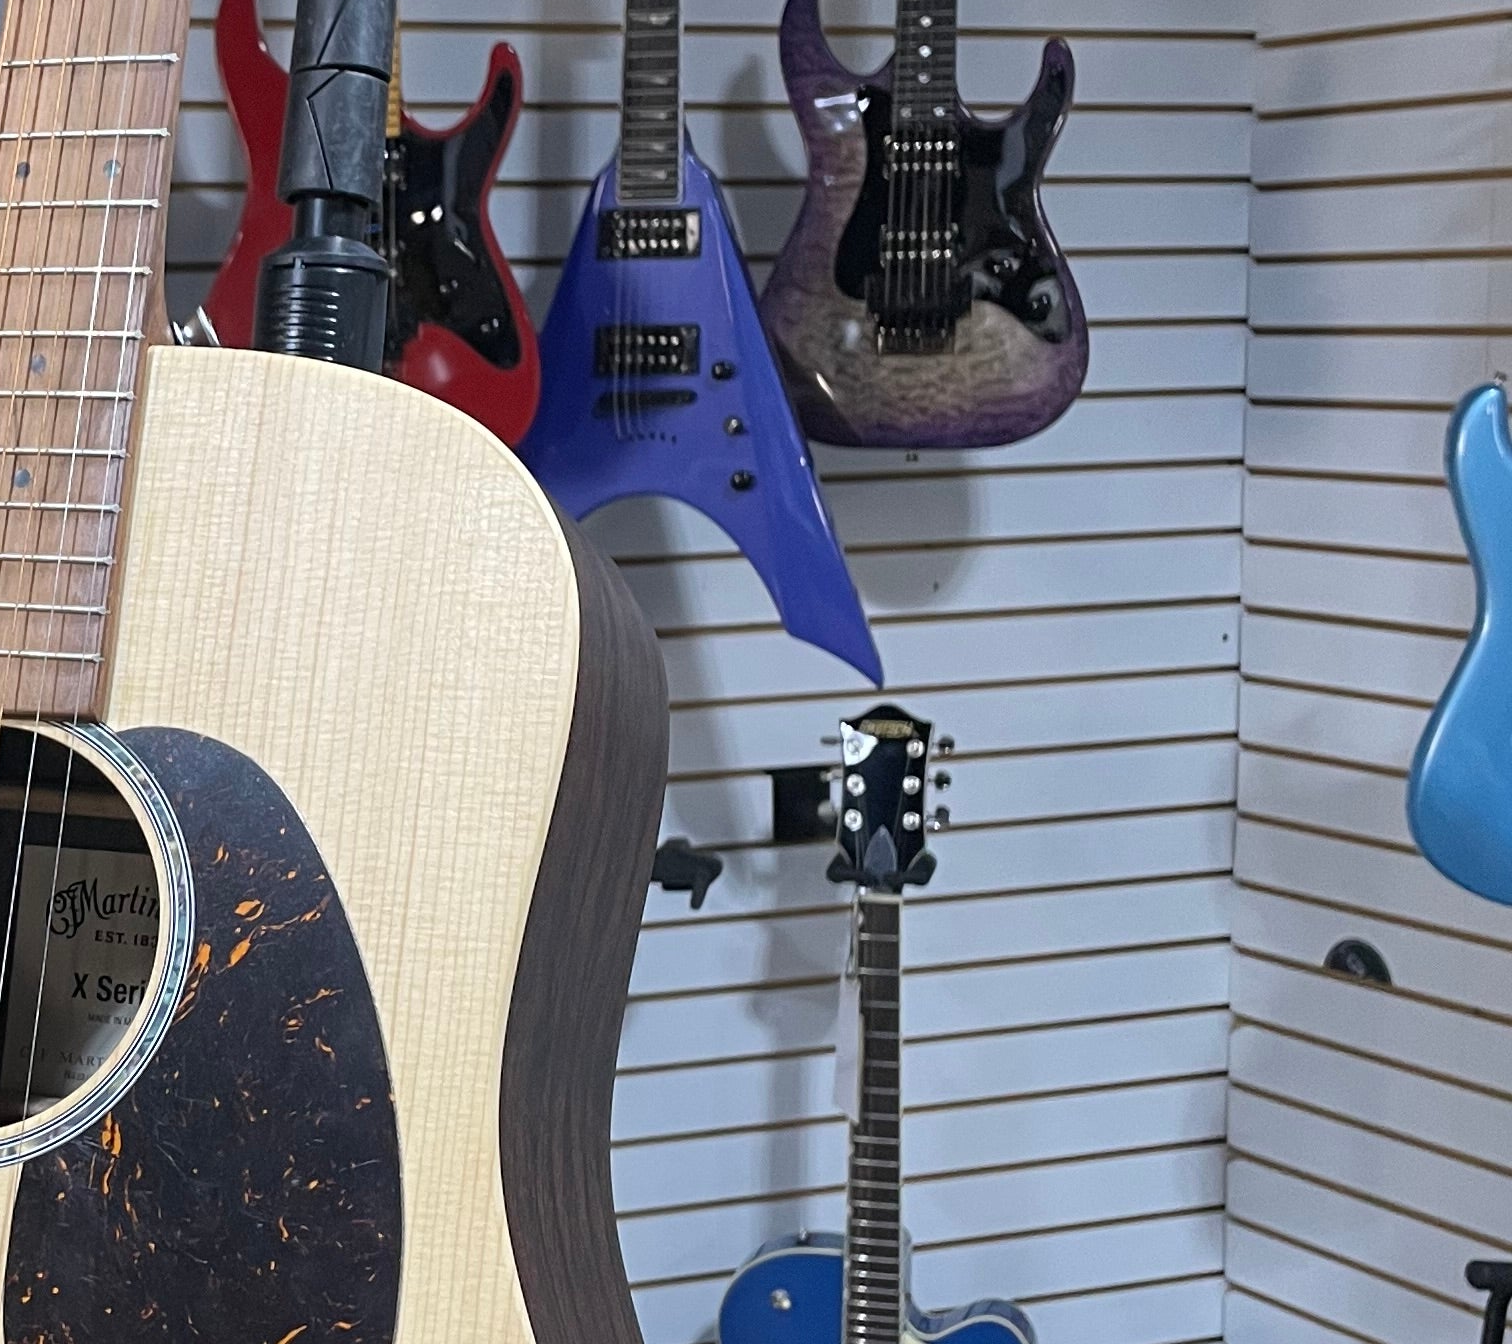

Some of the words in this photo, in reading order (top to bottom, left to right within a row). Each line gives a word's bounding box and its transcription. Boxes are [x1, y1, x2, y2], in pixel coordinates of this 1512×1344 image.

[94, 930, 128, 945] EST.
[133, 932, 158, 949] 183
[71, 972, 89, 1000] X
[96, 974, 146, 1006] Seri
